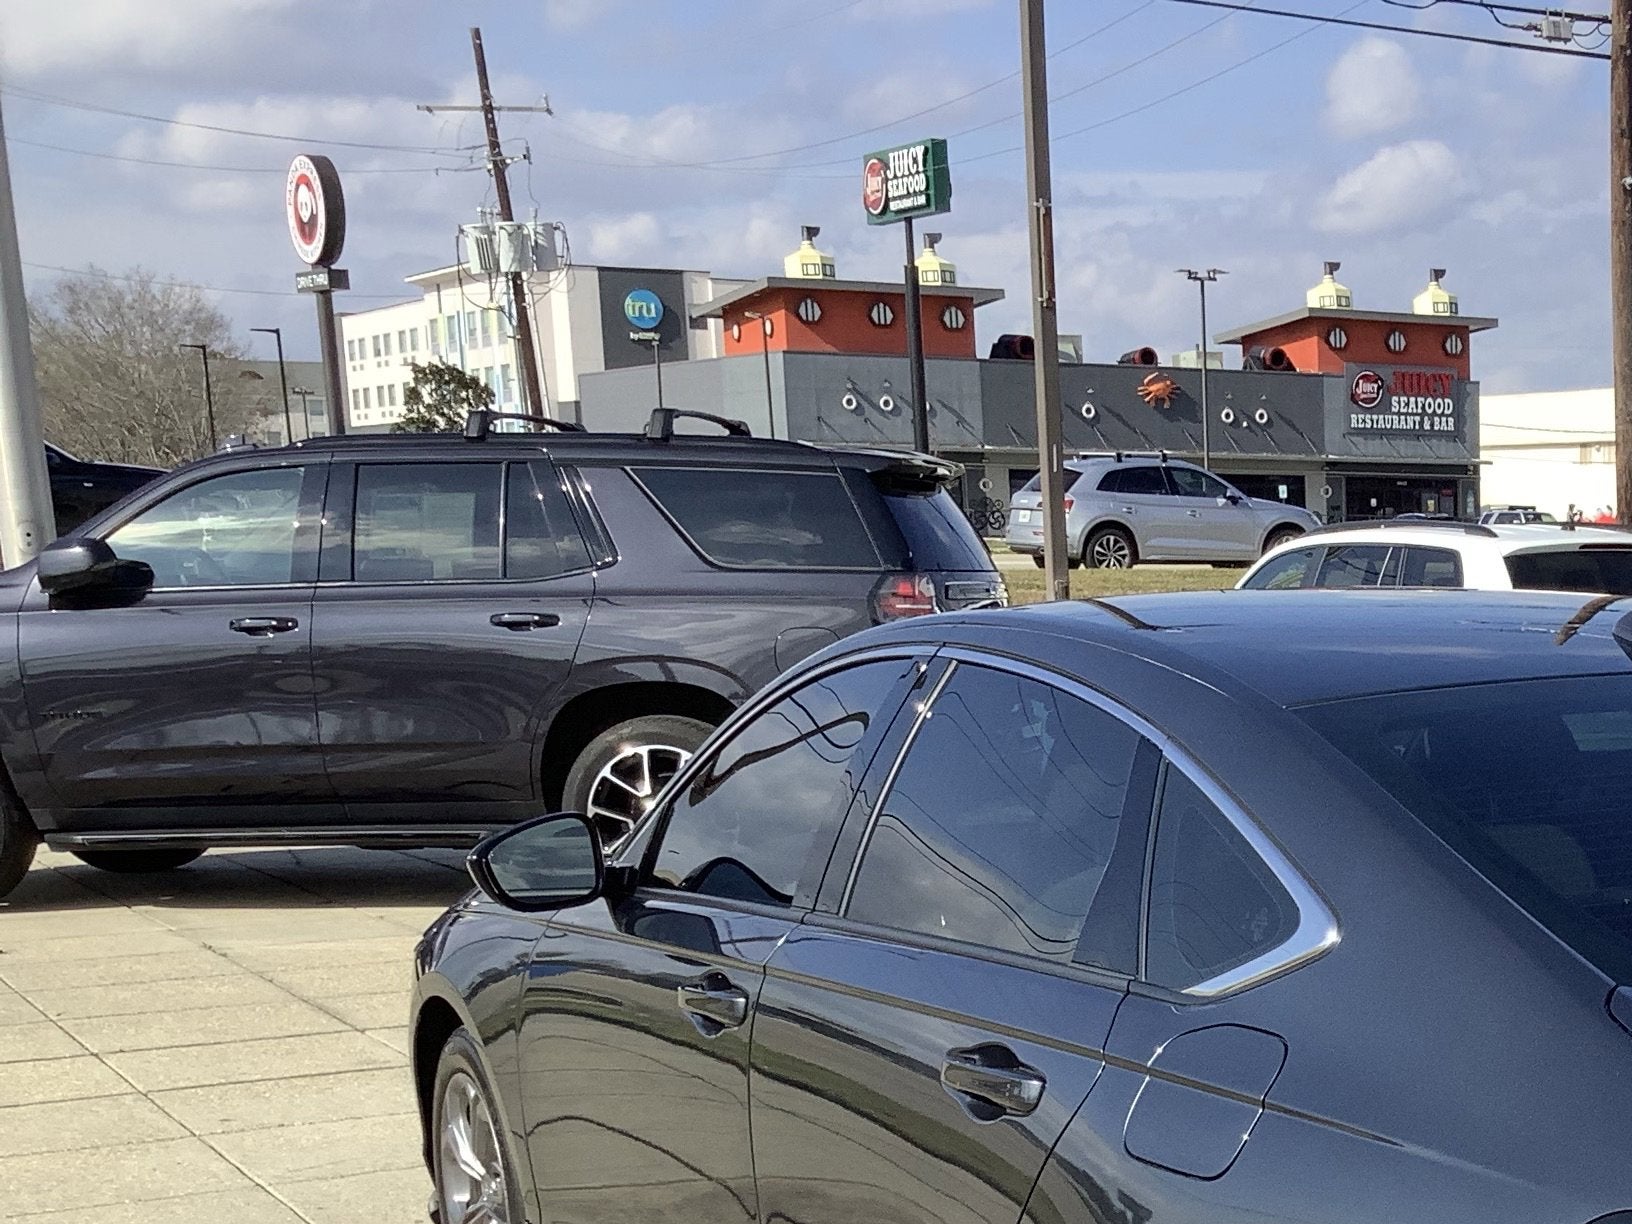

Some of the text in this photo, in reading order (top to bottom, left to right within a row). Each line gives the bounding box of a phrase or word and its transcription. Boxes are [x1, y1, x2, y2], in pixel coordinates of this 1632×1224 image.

[886, 145, 924, 179] JUICY
[887, 173, 927, 198] SEAFOOD
[625, 297, 656, 317] tru
[1387, 370, 1452, 397] JUICY
[1391, 396, 1453, 414] SEAFOOD
[1350, 414, 1455, 431] RESTAURANT & BAR
